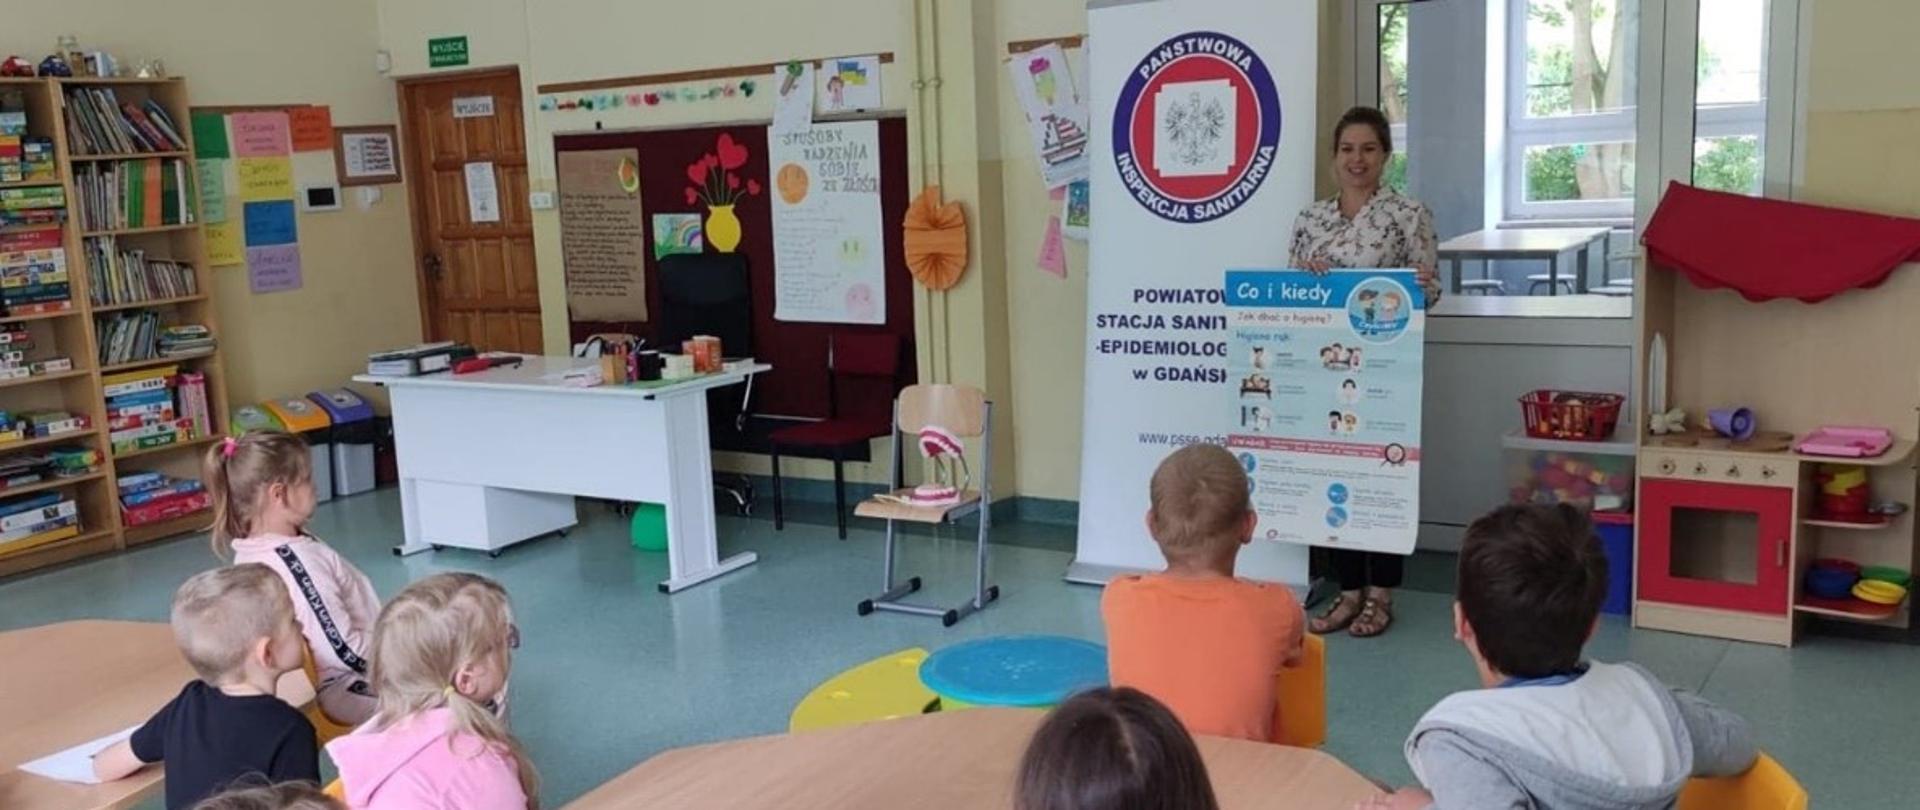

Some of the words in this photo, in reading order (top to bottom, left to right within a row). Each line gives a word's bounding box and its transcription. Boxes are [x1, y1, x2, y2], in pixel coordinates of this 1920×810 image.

[1139, 37, 1253, 79] PAŃSTWOWA
[1117, 151, 1189, 220] INSPEKCJA
[1194, 145, 1275, 220] SANITARNA
[1237, 282, 1259, 299] Co
[1267, 282, 1273, 299] i
[1281, 283, 1332, 306] kiedy
[1096, 314, 1166, 330] STACJA
[1133, 369, 1148, 380] w
